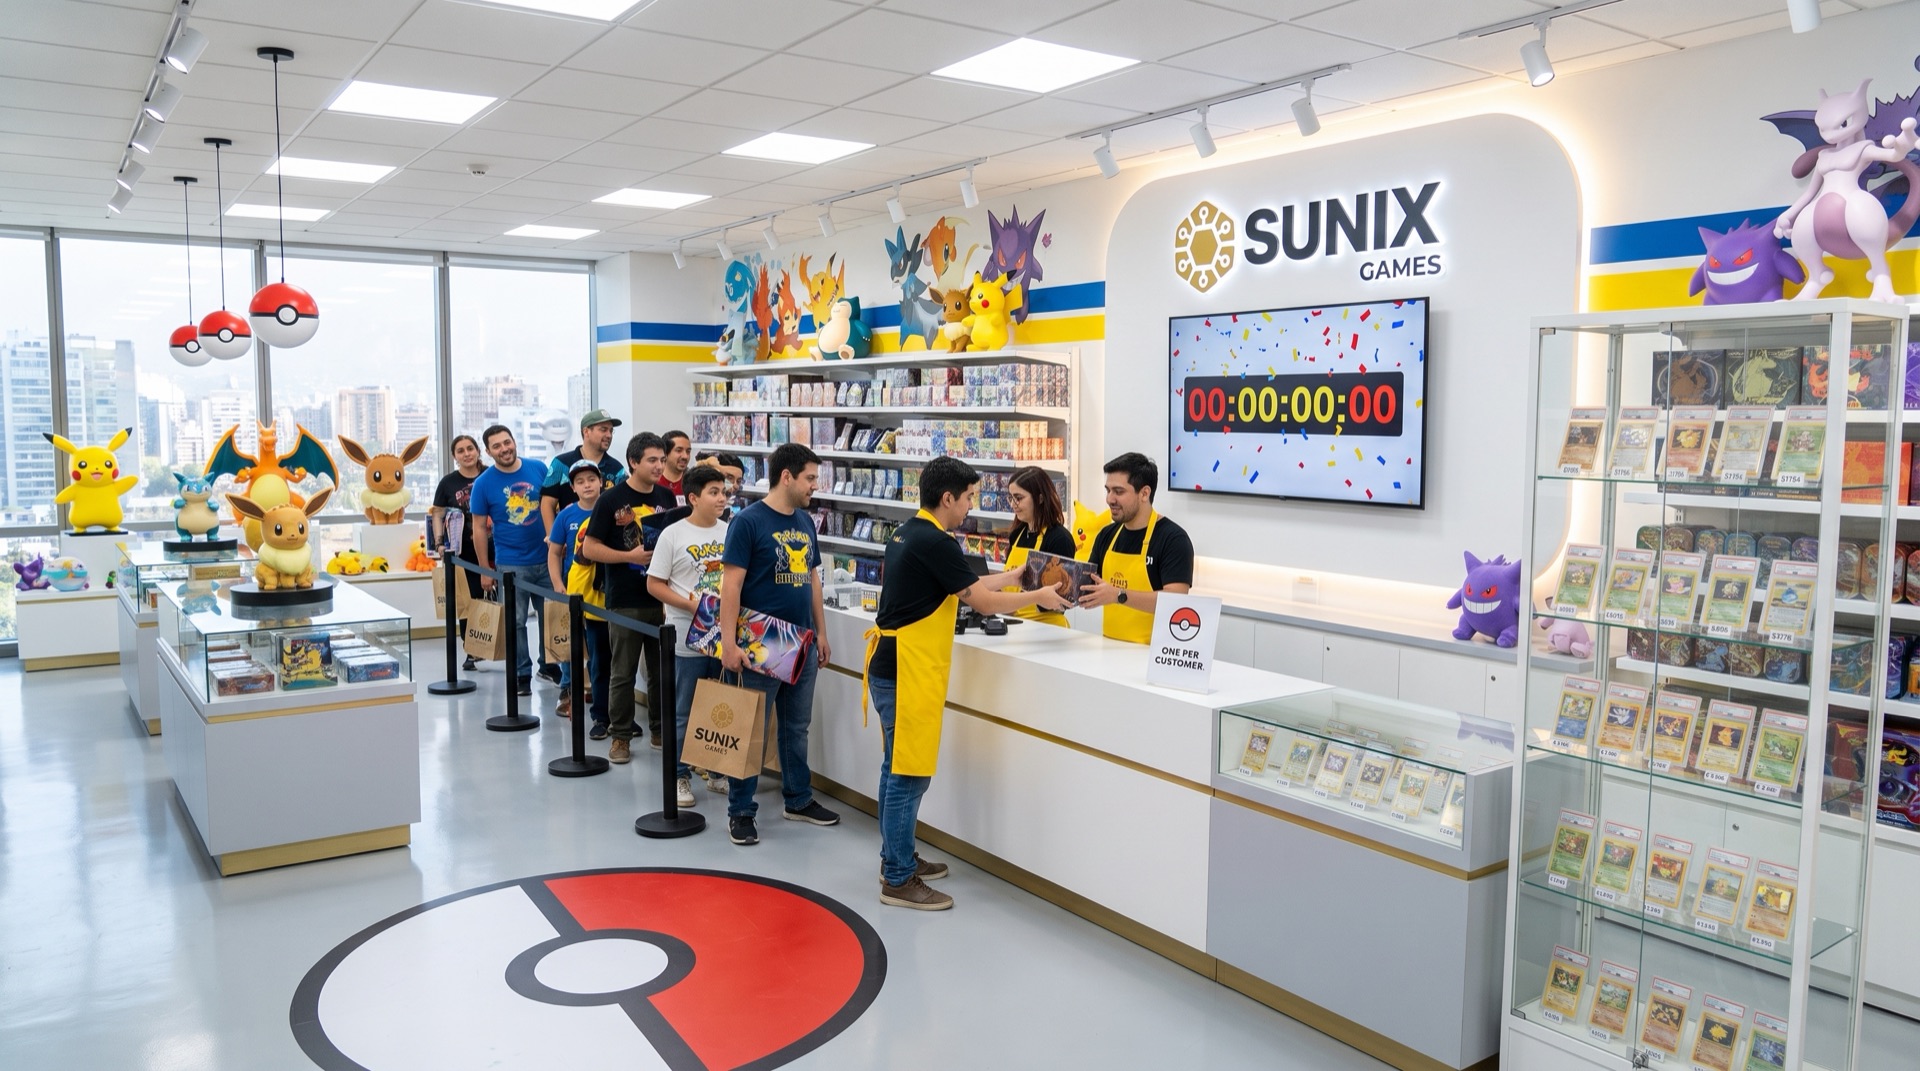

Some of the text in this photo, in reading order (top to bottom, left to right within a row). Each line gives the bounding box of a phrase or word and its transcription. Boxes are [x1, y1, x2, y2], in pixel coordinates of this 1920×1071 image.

[1243, 181, 1441, 266] SUNIX
[1359, 254, 1442, 282] GAMES
[1188, 384, 1397, 424] 00:00:00:00
[469, 628, 493, 643] SUNIX
[1161, 646, 1200, 659] ONE PER
[1155, 656, 1205, 671] CUSTOMER.
[694, 727, 741, 751] SUNIX
[704, 743, 728, 756] GAMES
